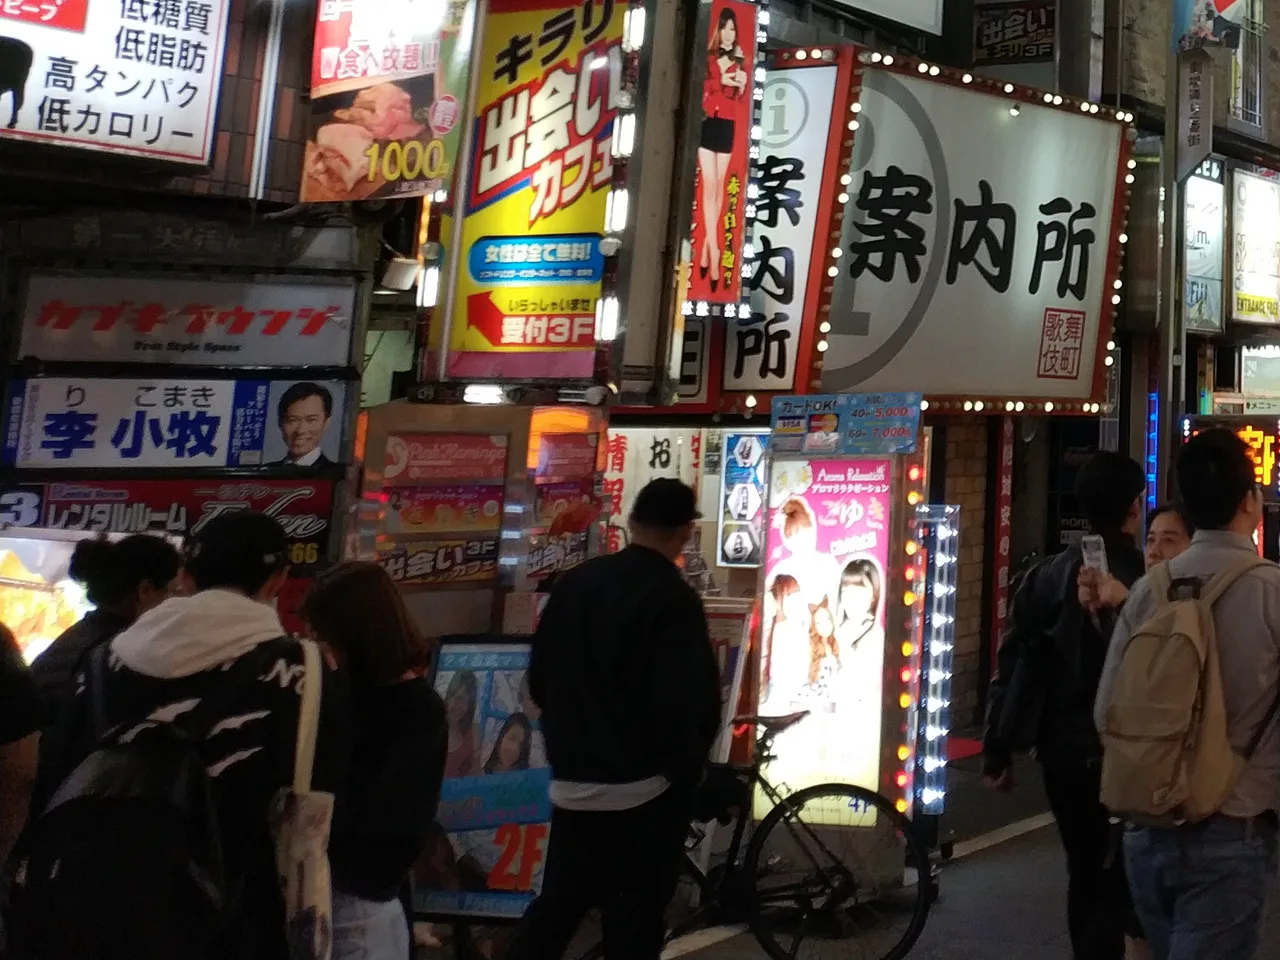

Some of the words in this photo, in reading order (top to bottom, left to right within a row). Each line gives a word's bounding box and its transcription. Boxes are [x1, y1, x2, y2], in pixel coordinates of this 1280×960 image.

[114, 26, 208, 74] 低脂肪
[982, 7, 1049, 47] 出会い
[1025, 42, 1053, 56] 3F
[44, 56, 199, 109] 高タンパク
[38, 95, 195, 145] 低カロリー
[478, 45, 624, 197] 出会い
[528, 137, 614, 230] カフェ
[850, 164, 1098, 302] 案内所
[734, 155, 806, 381] 案内所
[37, 299, 347, 336] カブキラウンジ
[500, 316, 594, 344] 受付3F
[65, 385, 87, 407] り
[134, 385, 215, 408] こまき
[40, 410, 98, 459] 李
[110, 410, 221, 458] 小牧
[48, 503, 188, 532] レンタルルーム
[467, 541, 496, 556] 3F
[486, 822, 548, 890] 2F
